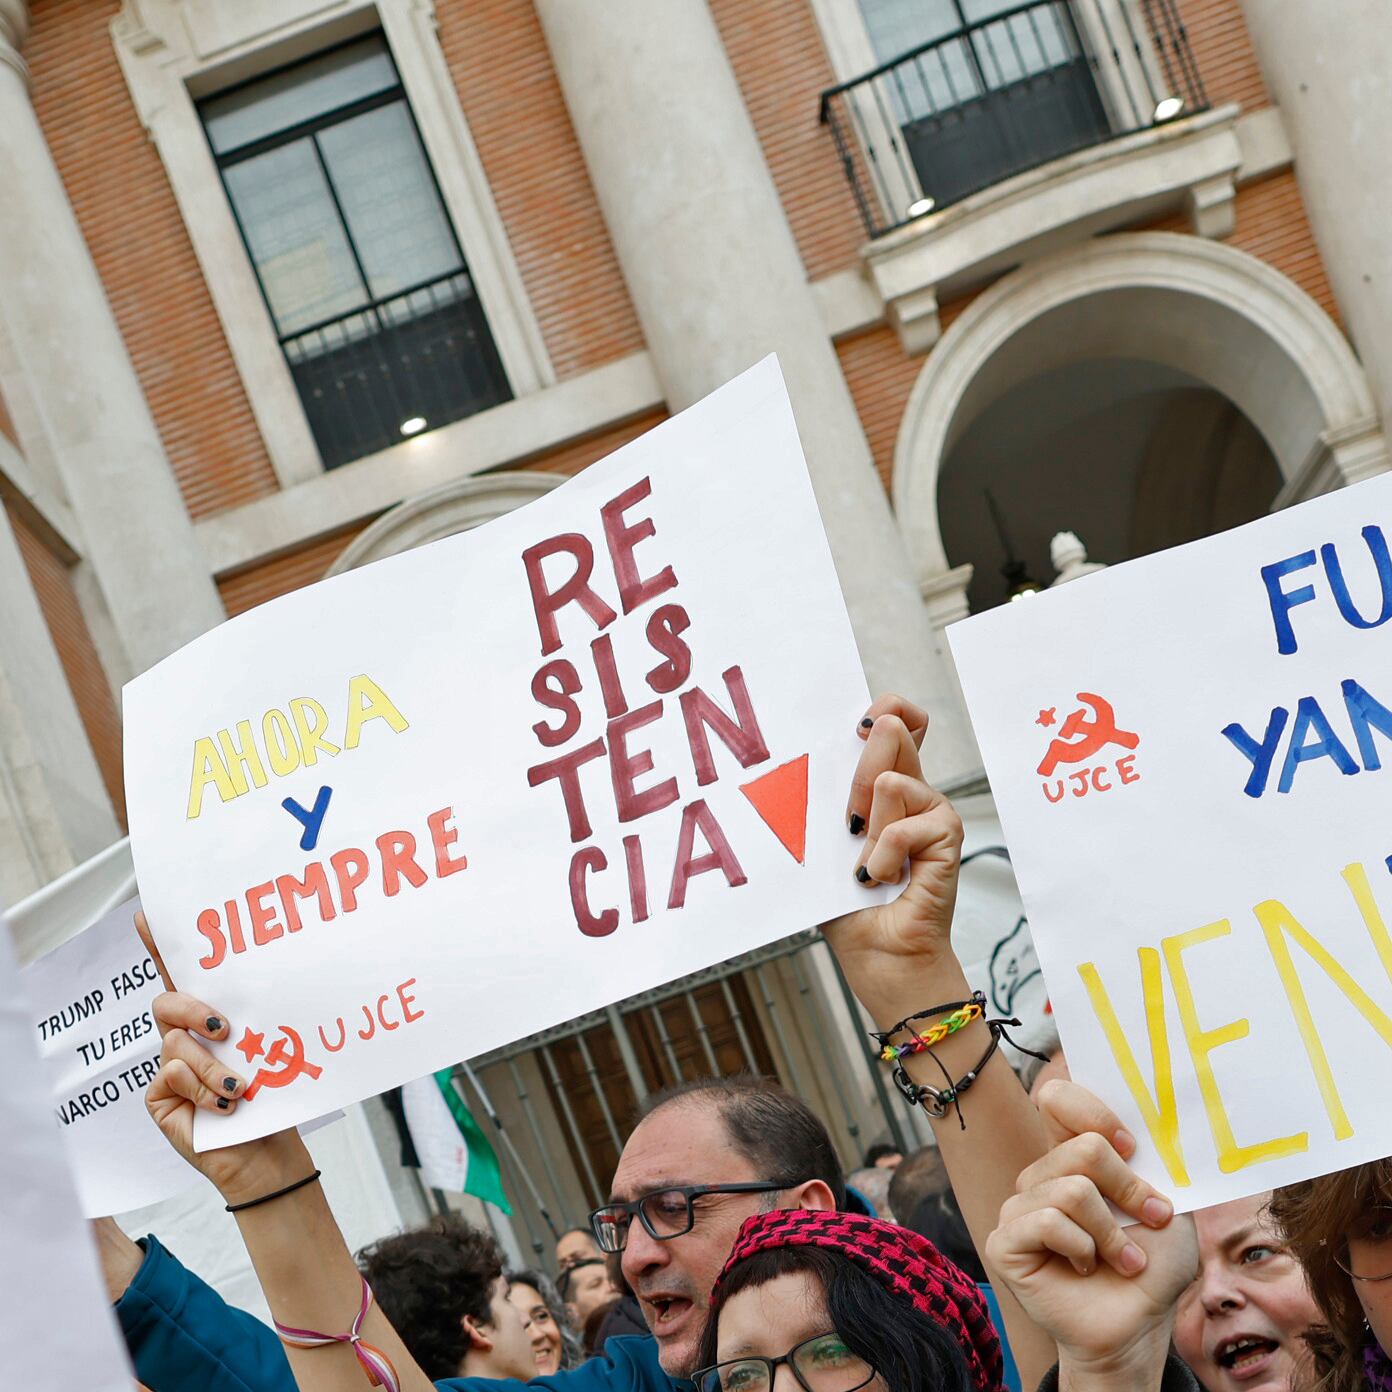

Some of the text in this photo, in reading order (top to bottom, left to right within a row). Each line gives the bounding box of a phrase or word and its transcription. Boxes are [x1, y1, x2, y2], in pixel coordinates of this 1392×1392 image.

[521, 475, 679, 656] RE
[531, 602, 691, 747] SIS
[187, 673, 409, 820] AHORA
[528, 665, 769, 842] TEN
[1042, 755, 1141, 802] UJCE
[281, 785, 332, 852] Y
[569, 798, 747, 938] CIA
[197, 806, 467, 970] SIEMPRE
[38, 958, 161, 1041] TRUMP FASC
[77, 1012, 153, 1067] TU ERES
[318, 977, 425, 1052] UJCE
[56, 1080, 119, 1126] NARCO
